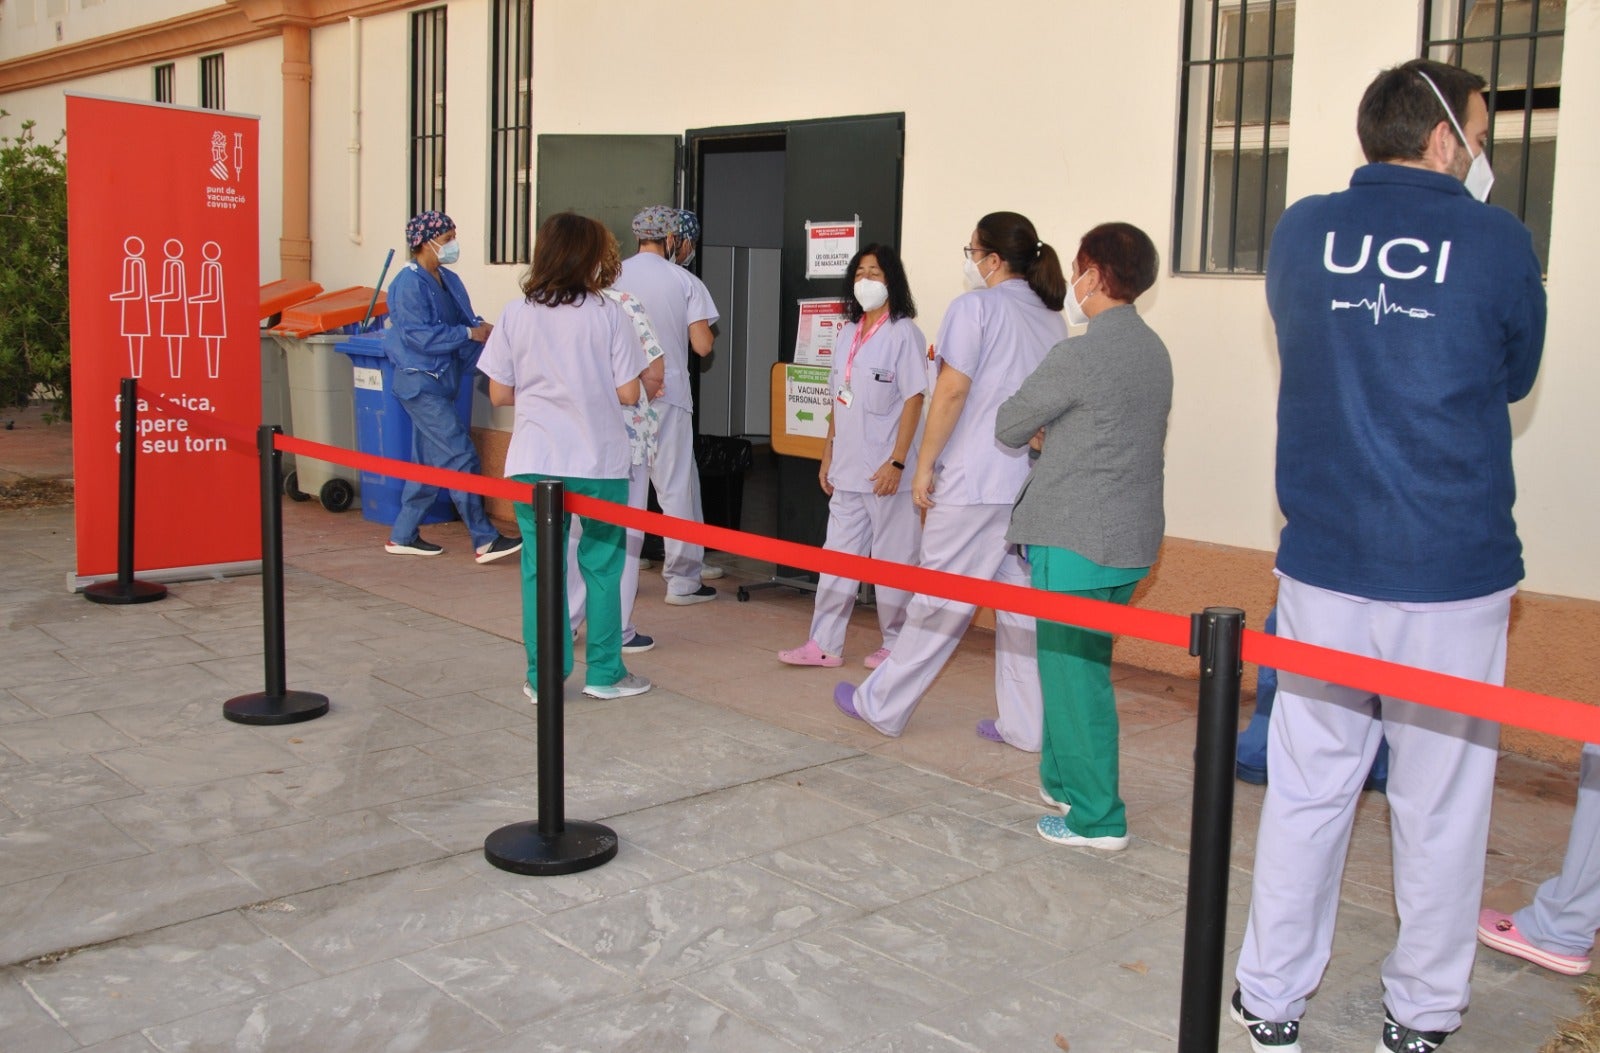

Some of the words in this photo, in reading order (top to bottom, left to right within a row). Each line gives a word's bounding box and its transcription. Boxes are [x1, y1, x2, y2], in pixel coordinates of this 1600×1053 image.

[226, 187, 236, 195] de
[207, 194, 246, 204] vacunació
[1323, 230, 1452, 284] UCI
[114, 394, 149, 412] fa
[788, 394, 821, 405] PERSONAL
[142, 439, 179, 454] seu
[184, 435, 228, 453] torn
